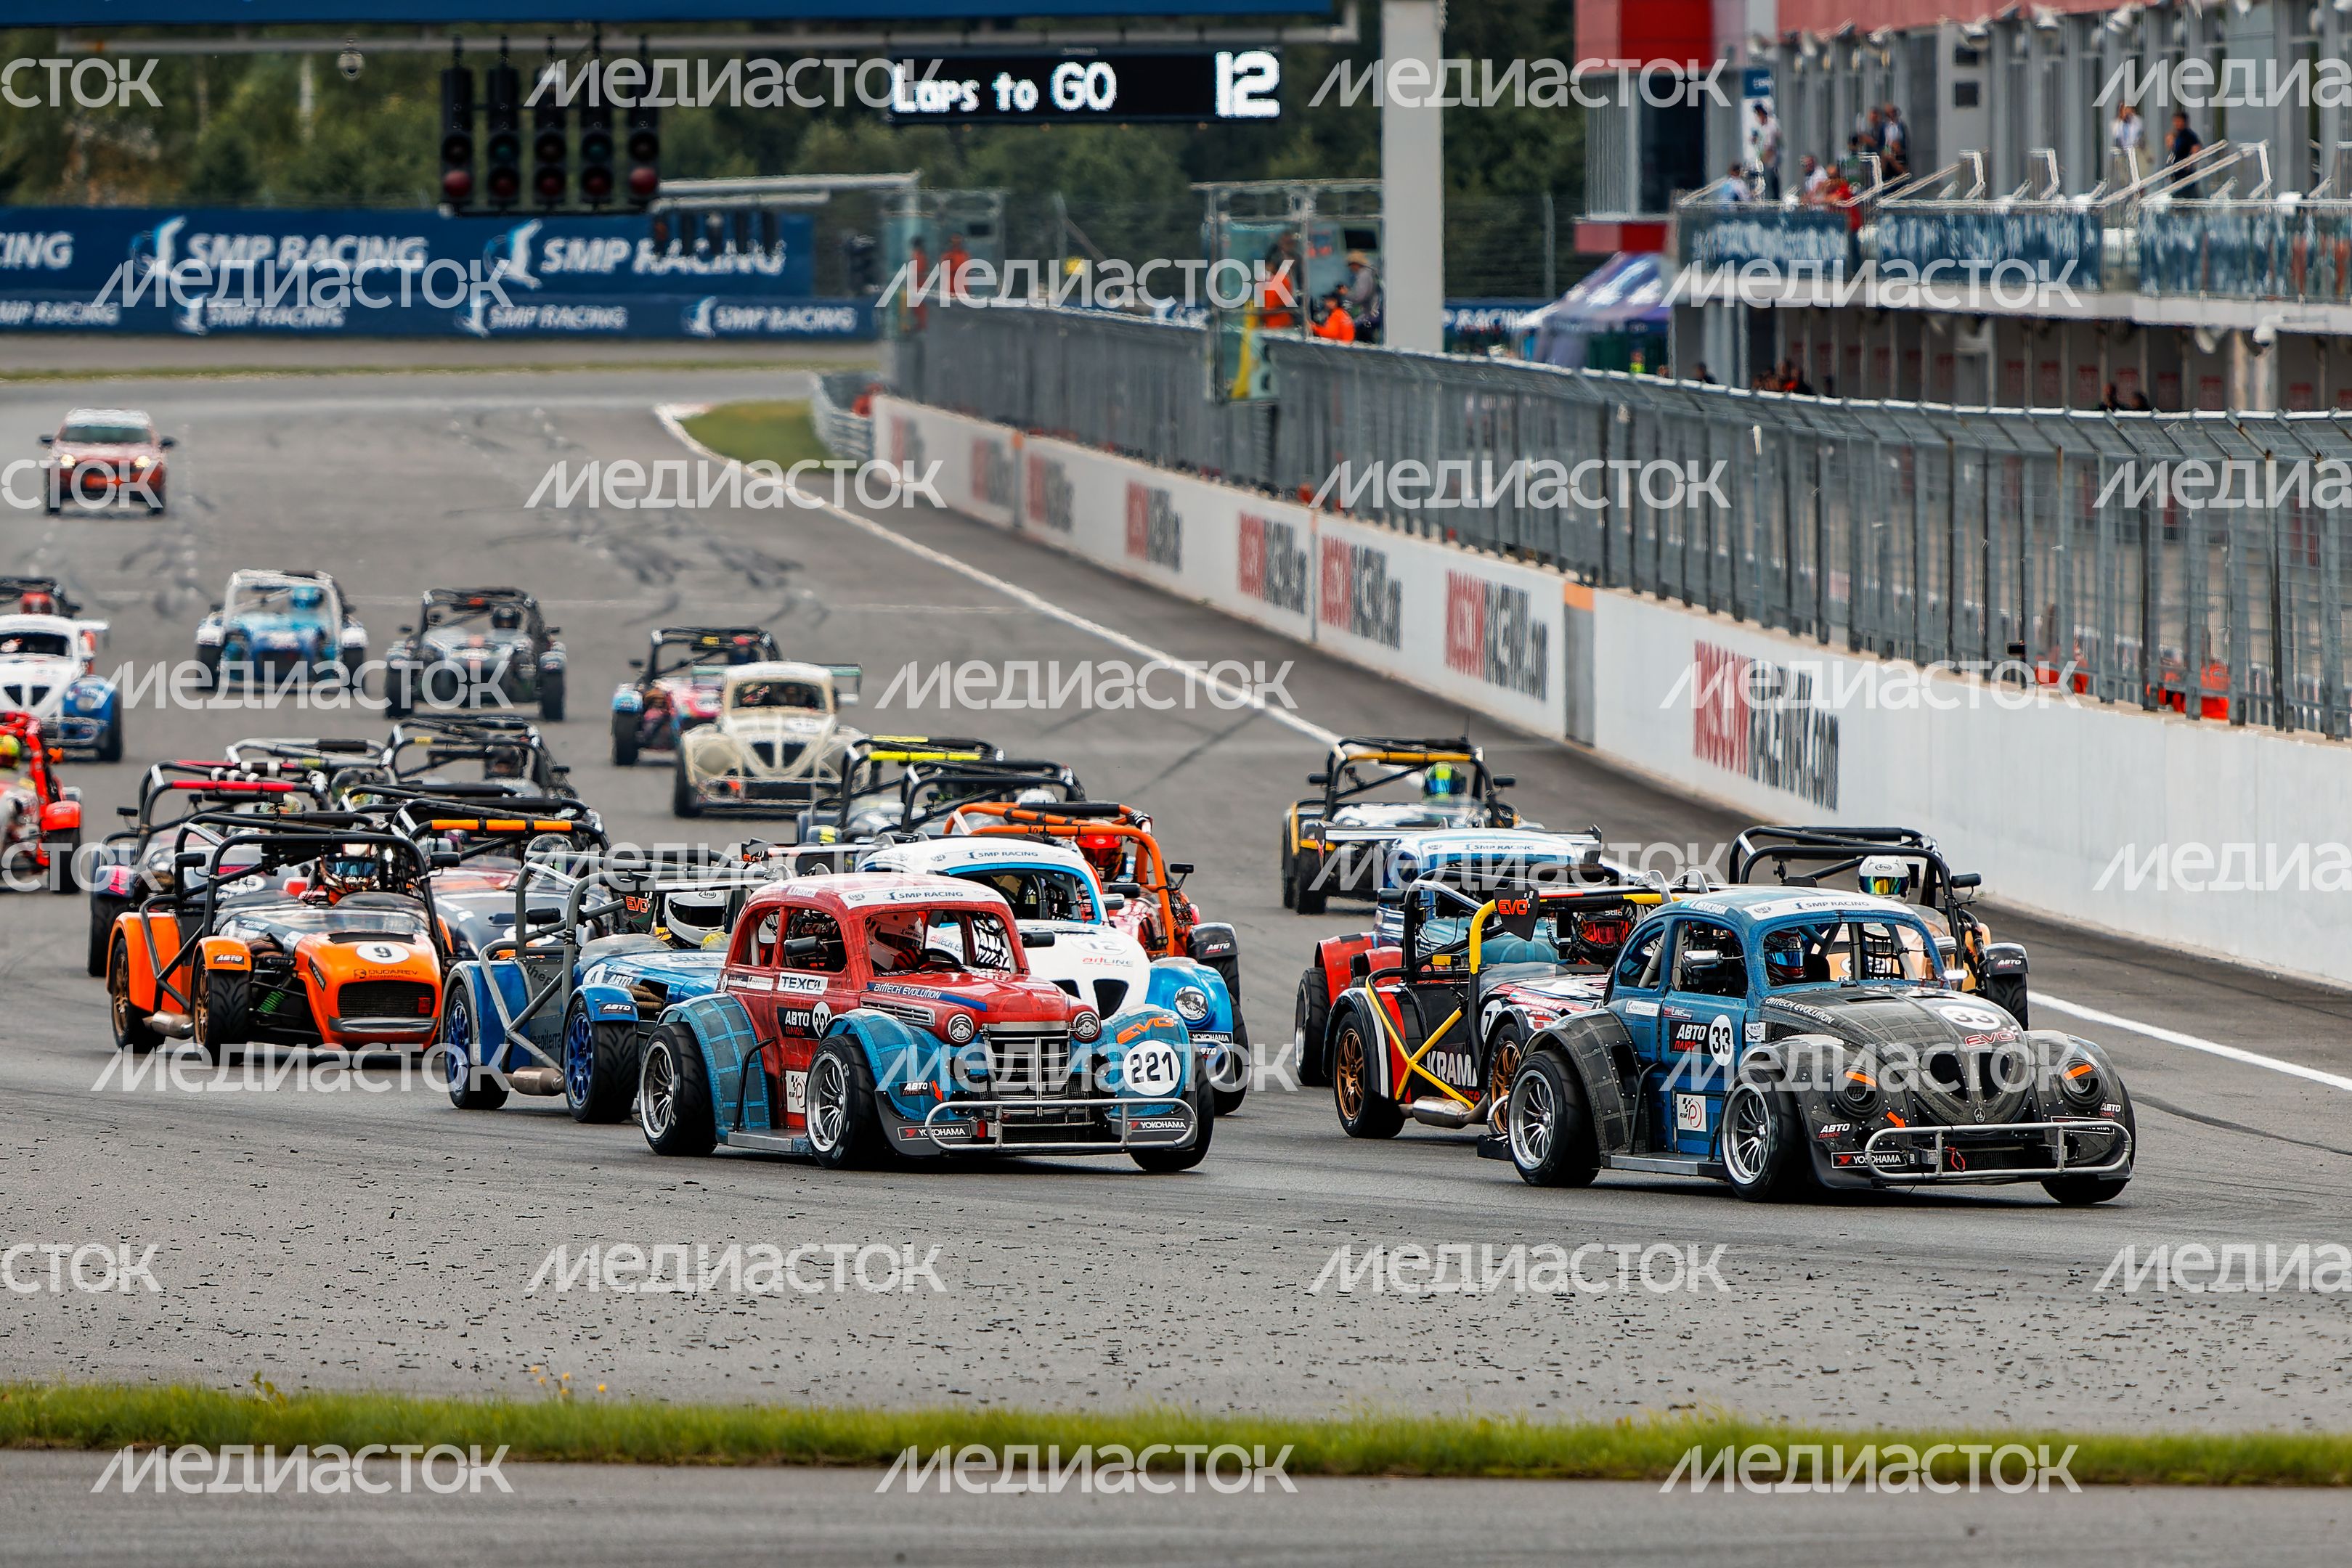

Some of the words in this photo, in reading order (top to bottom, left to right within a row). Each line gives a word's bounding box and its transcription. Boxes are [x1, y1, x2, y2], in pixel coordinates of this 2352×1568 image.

[892, 63, 980, 113] Laps
[993, 72, 1039, 111] to
[1051, 62, 1117, 111] GO
[1215, 50, 1281, 118] 12
[0, 232, 74, 270] ING
[187, 233, 277, 271] SMP
[277, 234, 430, 274] RACING
[540, 237, 632, 274] SMP
[488, 303, 539, 330] SMP
[538, 305, 629, 331] RACING
[714, 306, 768, 332] SMP
[766, 306, 859, 332] RACING
[626, 896, 649, 913] EVO
[1497, 899, 1529, 915] EVO
[373, 946, 393, 958] 9
[785, 1010, 810, 1027] АВТО
[1117, 1017, 1176, 1044] EVO
[1192, 1033, 1229, 1042] YOKOHAMA
[1676, 1024, 1707, 1041] АВТО
[1674, 1041, 1696, 1051] ПЛЮС
[1712, 1026, 1731, 1055] 33
[1965, 1032, 2016, 1048] EVO
[1129, 1051, 1174, 1084] 221
[904, 1082, 928, 1091] АВТО
[2100, 1102, 2121, 1112] АВТО
[1140, 1121, 1187, 1130] YOKOHAMA
[1820, 1123, 1851, 1133] АВТО
[1852, 1154, 1901, 1164] YOOHAMA
